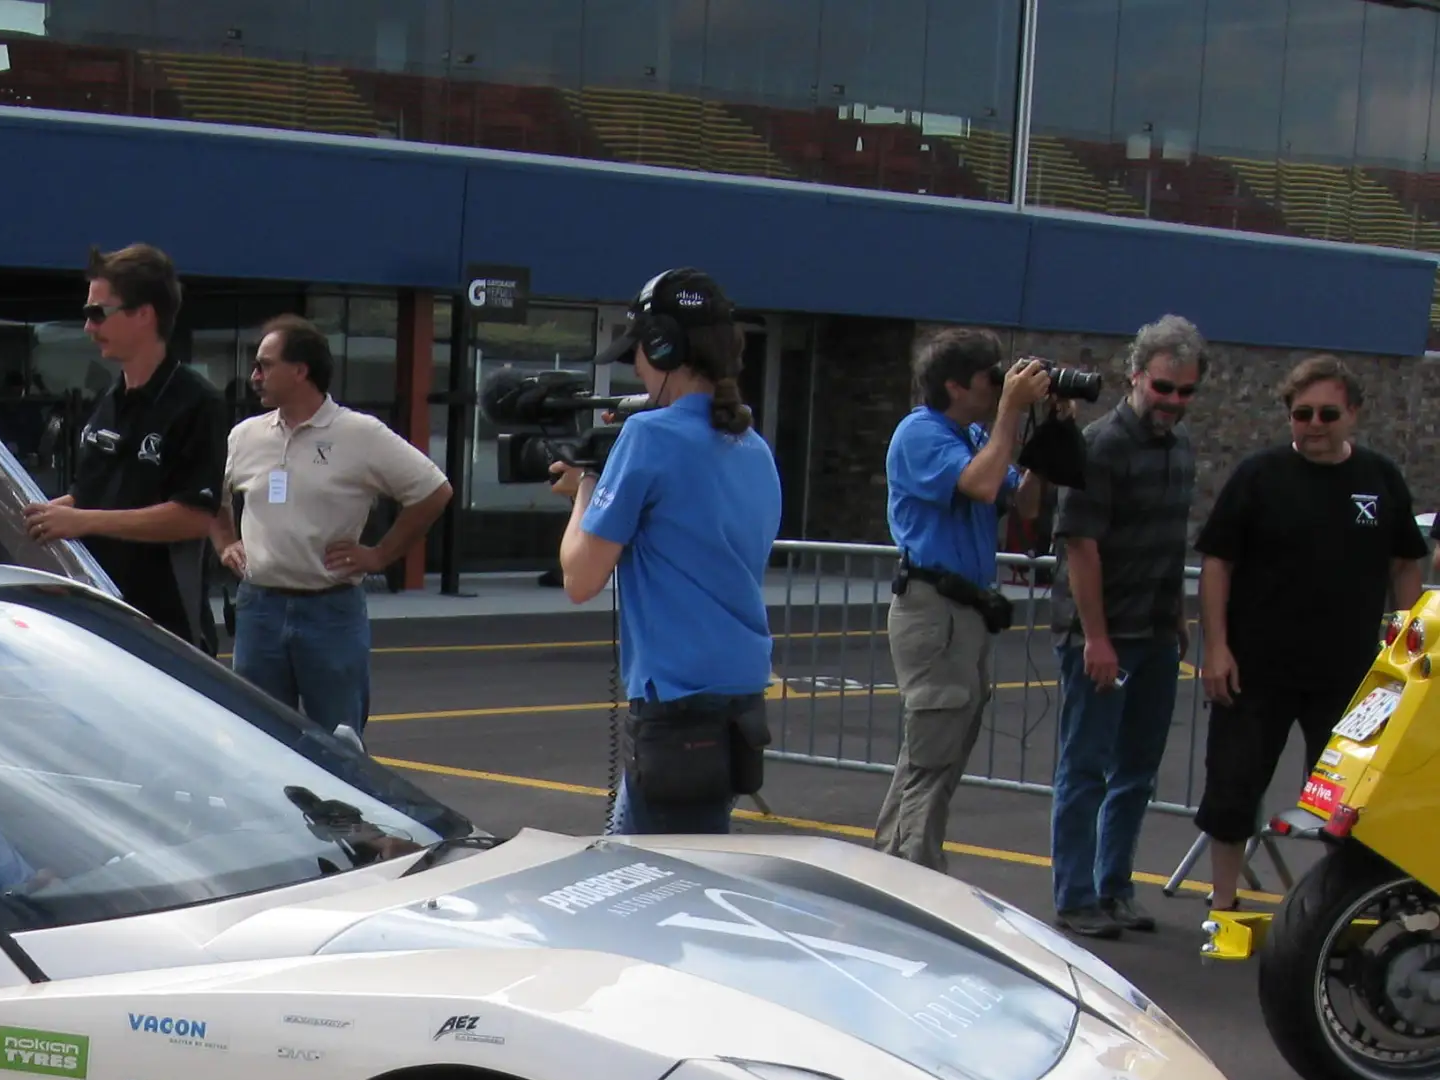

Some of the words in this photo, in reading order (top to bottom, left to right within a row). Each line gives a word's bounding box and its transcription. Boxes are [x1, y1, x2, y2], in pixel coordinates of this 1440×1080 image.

[128, 1012, 206, 1039] VACON
[433, 1015, 480, 1041] AEZ
[5, 1048, 78, 1070] TYRES
